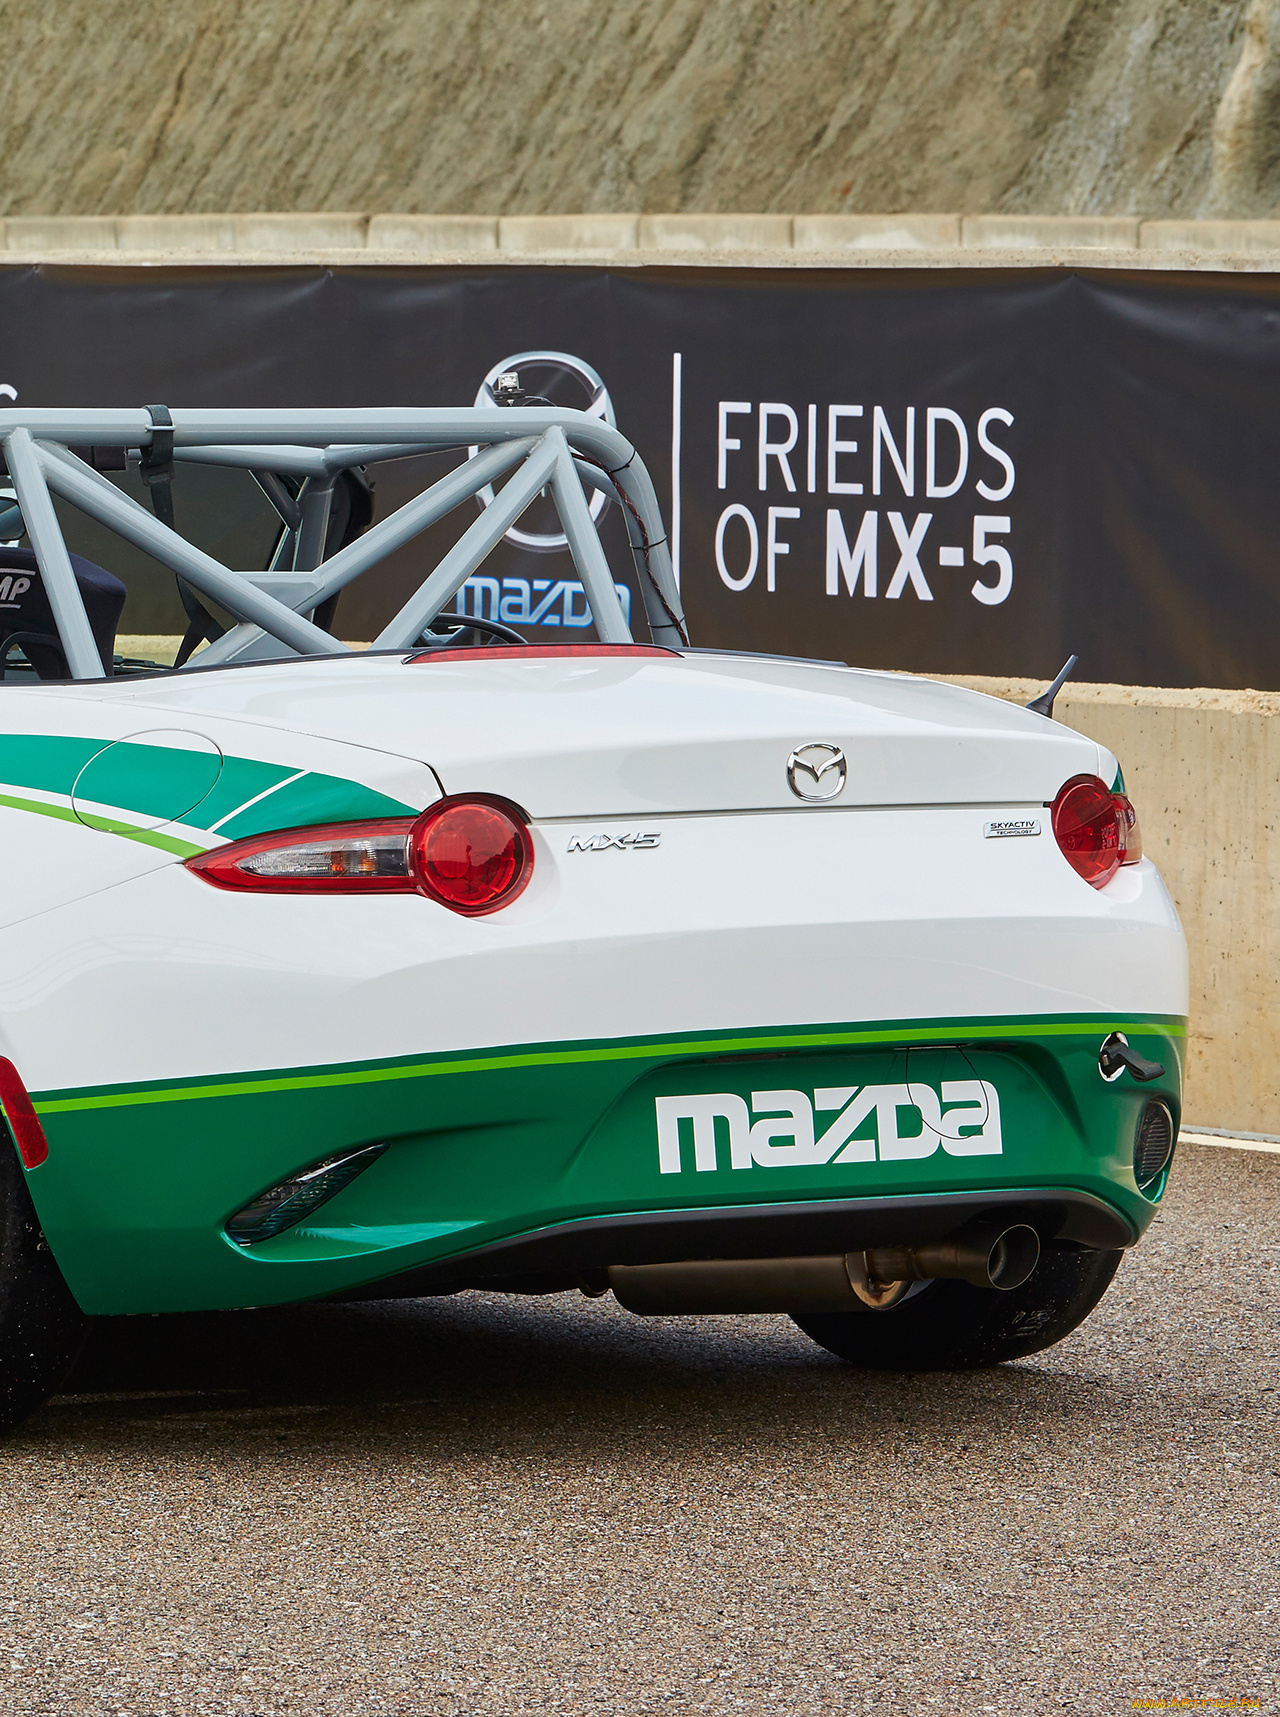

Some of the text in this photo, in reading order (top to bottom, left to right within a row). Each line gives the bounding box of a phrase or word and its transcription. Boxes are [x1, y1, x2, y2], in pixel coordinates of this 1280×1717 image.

[717, 401, 1015, 501] FRIENDS
[714, 504, 1014, 606] OF MX-5
[566, 832, 662, 853] MX-5
[990, 821, 1035, 830] SKYACTIV
